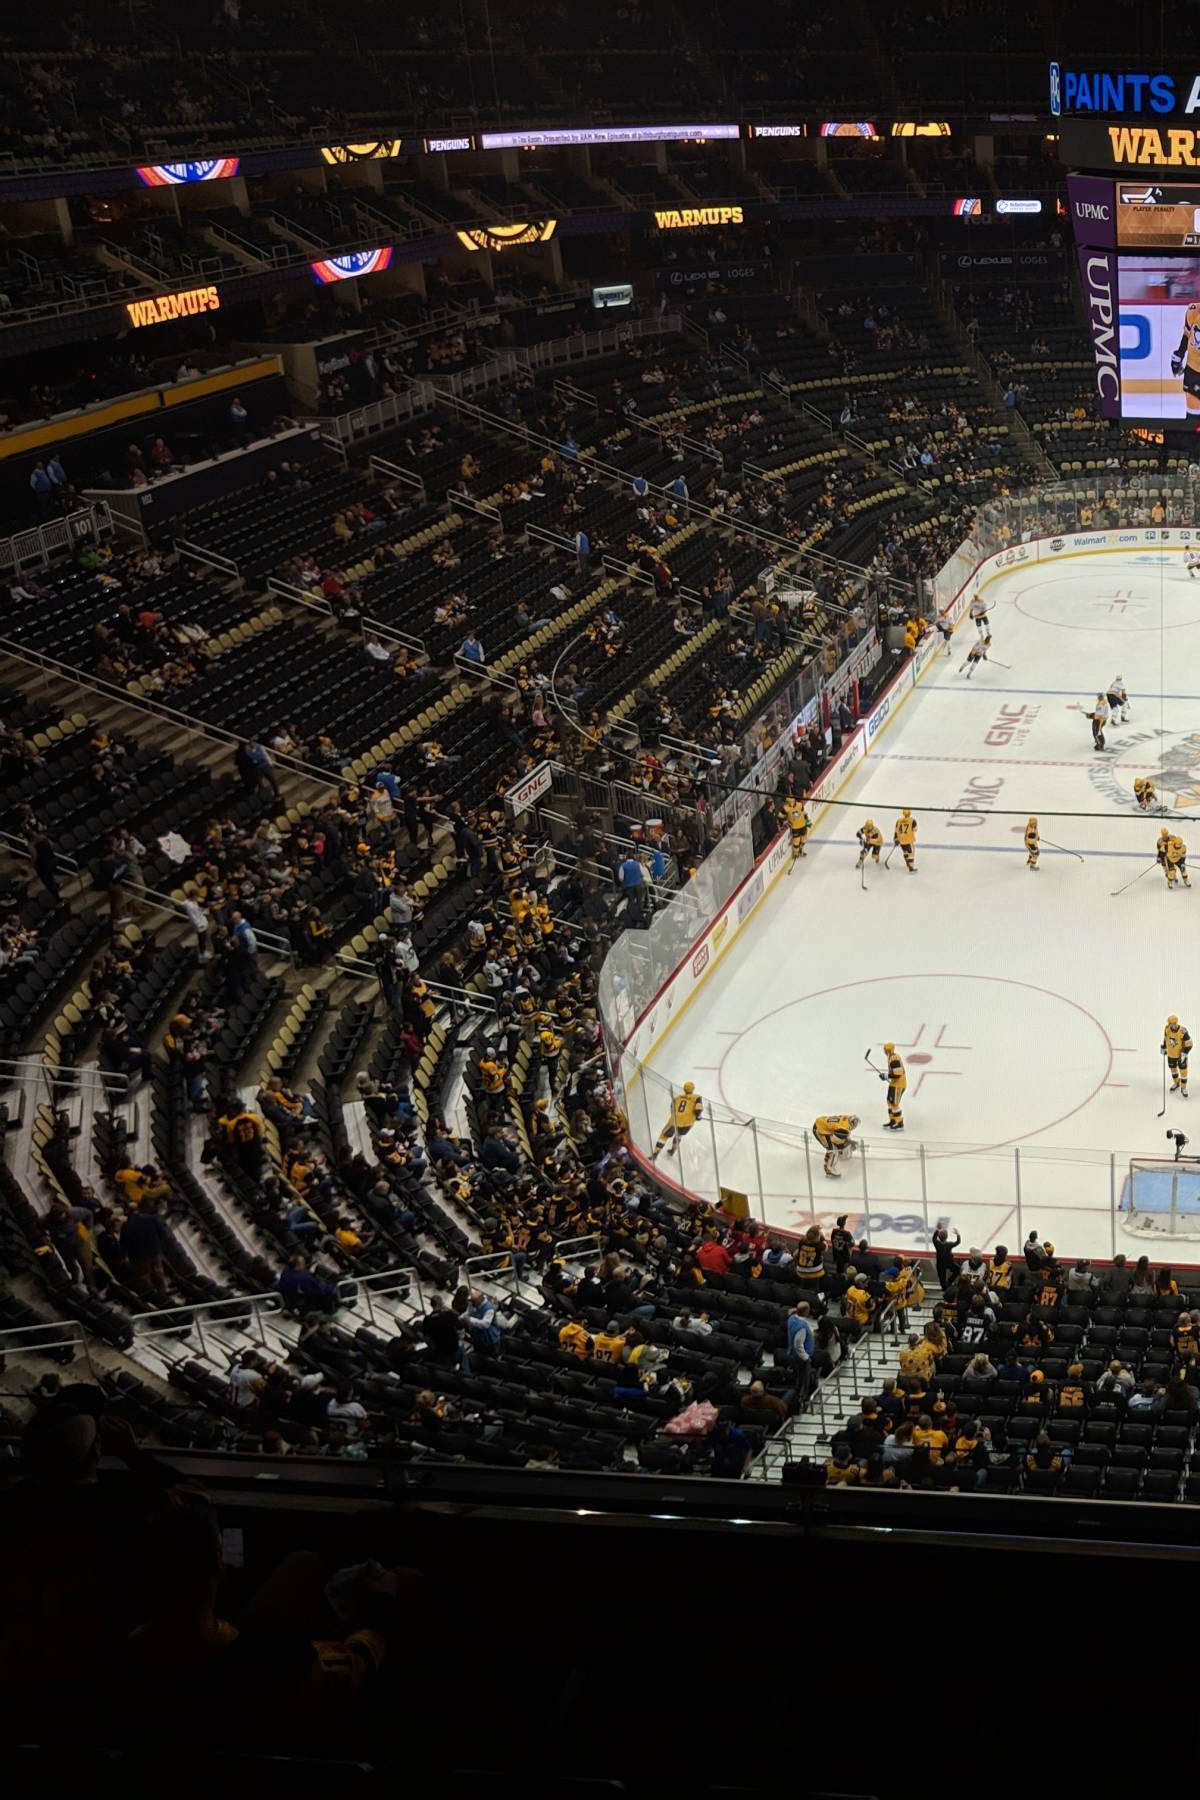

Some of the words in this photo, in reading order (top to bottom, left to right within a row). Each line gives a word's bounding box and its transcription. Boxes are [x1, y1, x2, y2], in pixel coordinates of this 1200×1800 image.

[1065, 72, 1176, 113] PAINTS
[429, 138, 470, 151] PENGUINS
[755, 126, 800, 137] PENGUINS
[654, 206, 743, 229] WARMUPS
[1076, 202, 1110, 220] UPMC
[1020, 256, 1048, 264] LOGES
[127, 286, 220, 328] WARMUPS
[1086, 254, 1119, 402] UPMC
[75, 519, 92, 536] 101
[1074, 536, 1106, 546] Walmart
[868, 699, 889, 737] GEICO
[984, 703, 1027, 746] GNC
[518, 771, 548, 801] GNC
[946, 776, 1005, 828] UPMC
